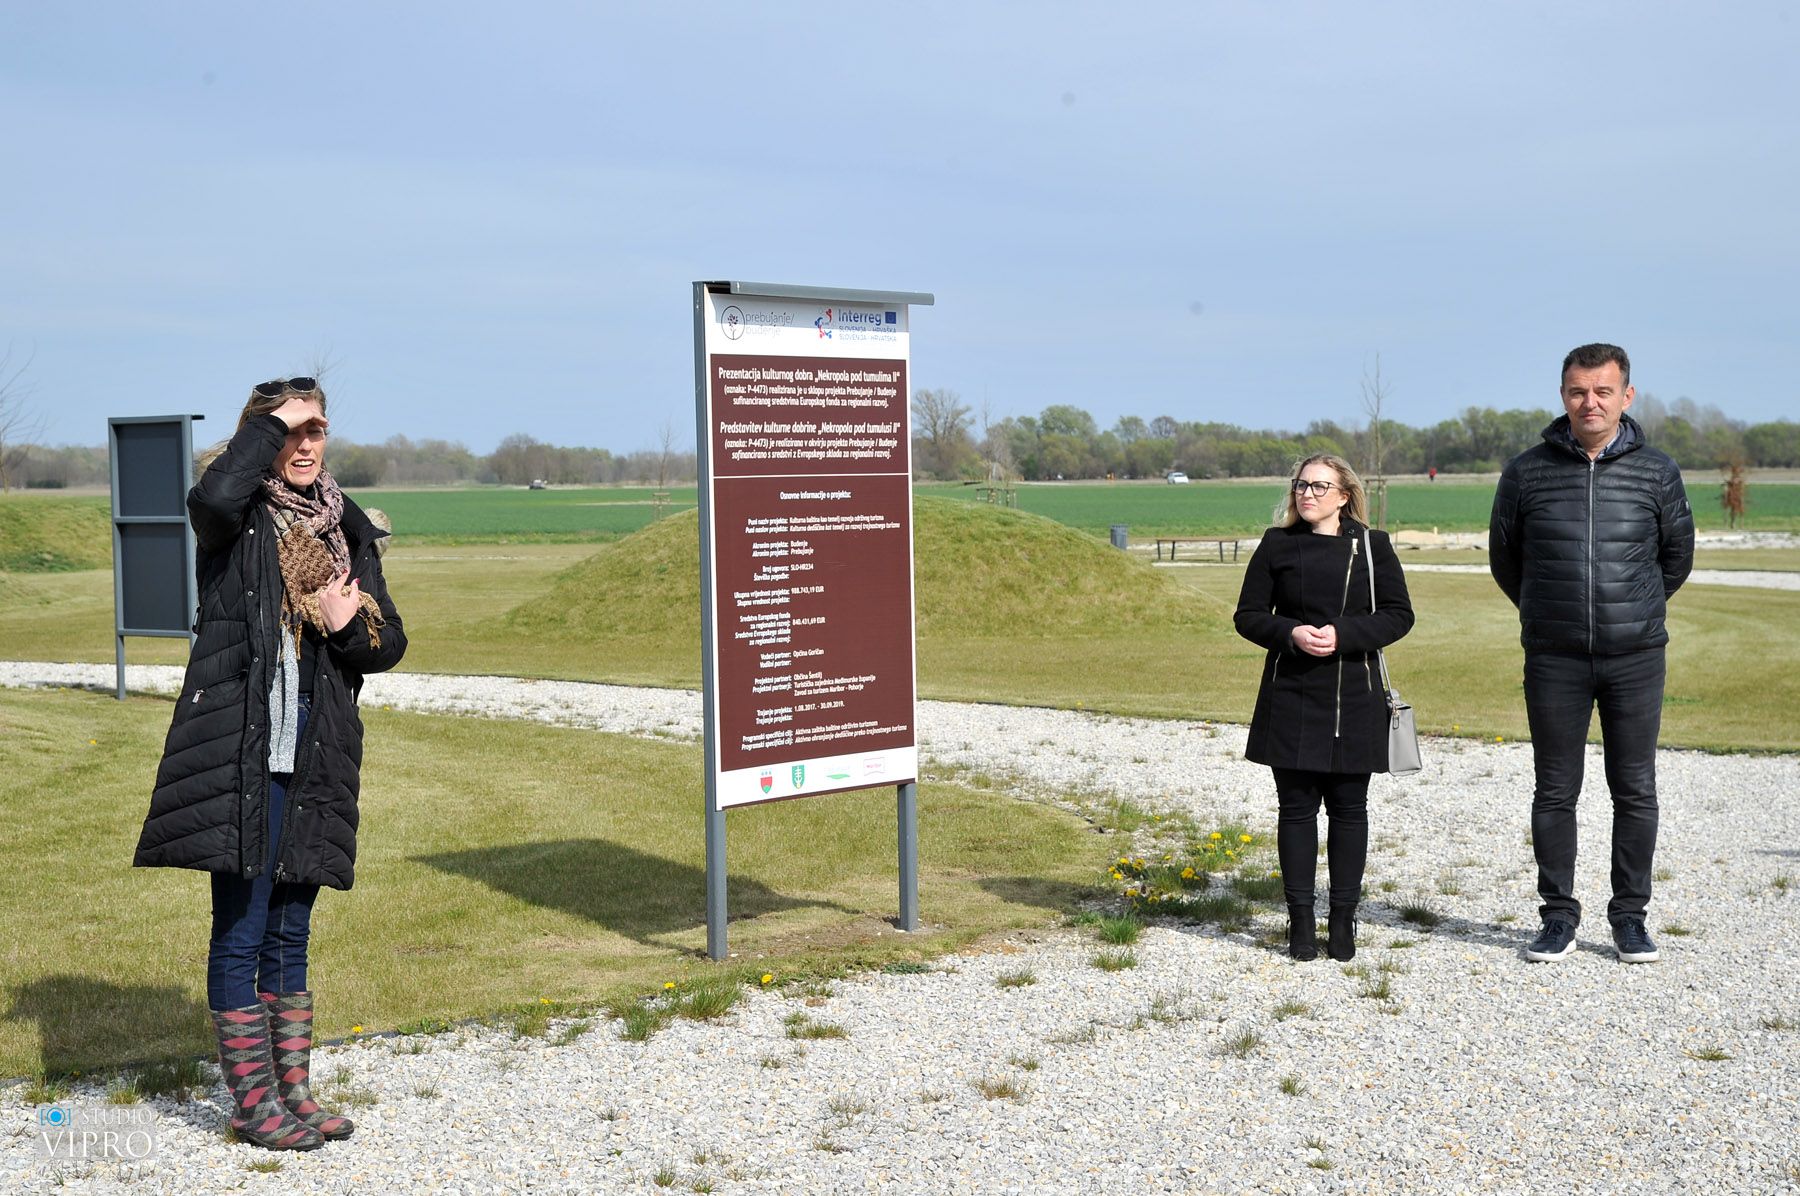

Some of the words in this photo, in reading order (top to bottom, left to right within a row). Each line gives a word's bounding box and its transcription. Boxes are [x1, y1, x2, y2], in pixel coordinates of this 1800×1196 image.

[746, 312, 794, 326] prebujanje/
[838, 309, 882, 326] Interreg
[719, 367, 760, 382] Prezentacija
[762, 368, 794, 382] kulturnog
[795, 369, 813, 380] dobra
[815, 370, 849, 383] „Nekropola
[851, 370, 862, 384] pod
[863, 371, 891, 382] tumulima
[724, 384, 746, 395] (oznaka:
[748, 384, 768, 395] P-4473)
[769, 385, 796, 394] realizirana
[808, 386, 824, 396] sklopu
[825, 386, 846, 396] projekta
[847, 387, 873, 397] Prebujanje
[877, 387, 896, 397] Buđenje
[733, 396, 770, 407] sufinanciranog
[772, 397, 799, 405] sredstvima
[800, 397, 825, 408] Europskog
[826, 397, 840, 406] fonda
[848, 398, 872, 408] regionalni
[873, 398, 889, 408] razvoj.
[720, 421, 762, 433] Predstavitev
[764, 421, 791, 433] kulturne
[792, 421, 816, 433] dobrine
[818, 422, 852, 436] „Nekropola
[854, 422, 866, 436] pod
[867, 422, 892, 433] tumulusi
[725, 439, 747, 449] (oznaka:
[748, 438, 768, 449] P-4473)
[776, 438, 803, 447] realizirana
[827, 438, 848, 449] projekta
[849, 438, 875, 449] Prebujanje
[732, 450, 767, 461] sofinancirano
[772, 450, 792, 458] sredstvi
[797, 449, 825, 460] Evropskega
[826, 449, 842, 458] sklada
[850, 449, 874, 460] regionalni
[875, 449, 891, 460] razvoj.
[780, 492, 800, 500] Osnovne
[800, 491, 826, 500] informacije
